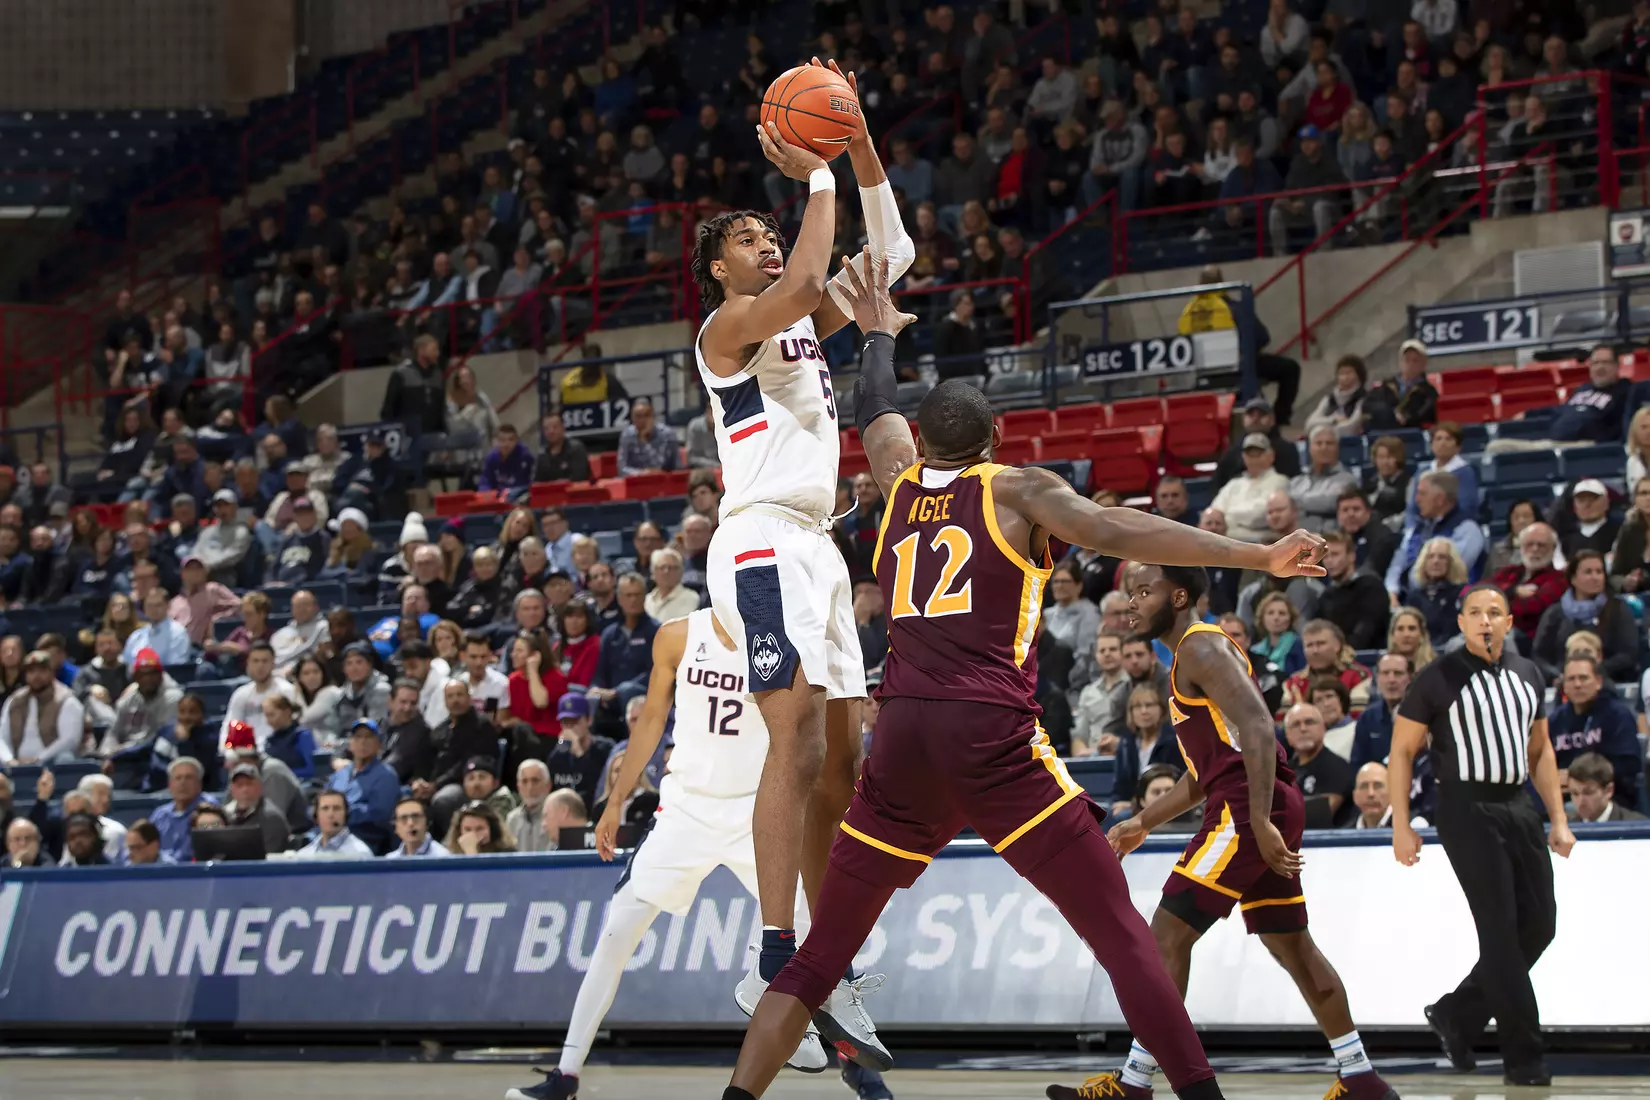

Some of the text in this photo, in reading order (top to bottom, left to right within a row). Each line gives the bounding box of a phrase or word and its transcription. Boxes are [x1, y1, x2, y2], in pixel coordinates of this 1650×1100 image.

[1422, 308, 1539, 343] SEC 121
[1085, 336, 1193, 372] SEC 120
[818, 369, 836, 420] 5
[562, 400, 630, 428] SEC 12
[907, 494, 954, 524] AGEE
[891, 525, 973, 621] 12
[708, 695, 743, 736] 12
[55, 902, 507, 977] CONNECTICUT
